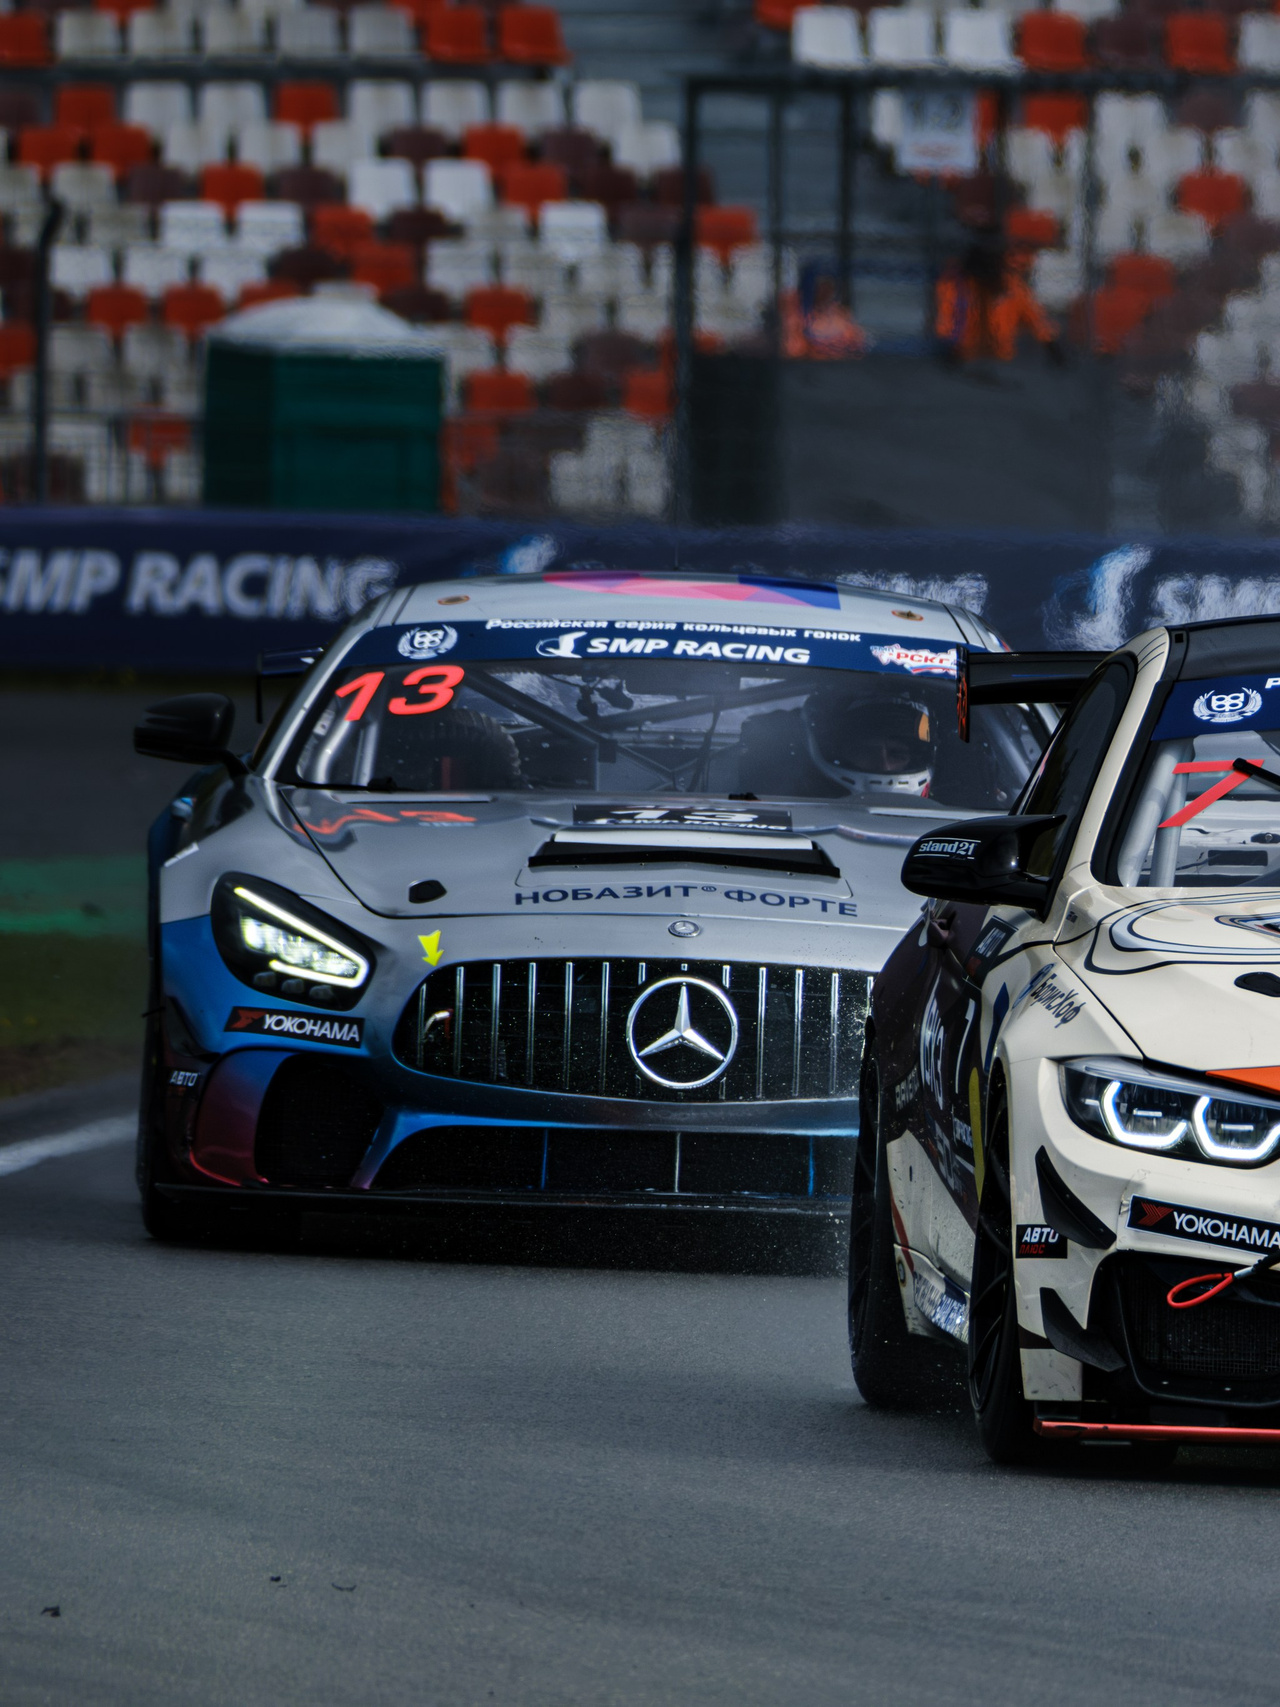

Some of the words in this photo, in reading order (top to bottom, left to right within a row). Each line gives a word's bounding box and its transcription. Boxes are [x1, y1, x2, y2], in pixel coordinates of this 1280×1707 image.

[0, 549, 121, 614] MP
[125, 551, 398, 621] RACING
[485, 617, 608, 630] Российская
[614, 619, 676, 632] серия
[683, 622, 797, 638] кольцевых
[804, 628, 861, 642] гонок
[586, 638, 668, 654] SMP
[672, 639, 811, 664] RACING
[335, 665, 465, 722] 13
[918, 841, 975, 858] stand21
[724, 889, 859, 918] ФОРТЕ
[263, 1013, 361, 1042] YOKOHAMA
[169, 1069, 200, 1087] АВТО
[1018, 1243, 1046, 1255] ПЛЮС
